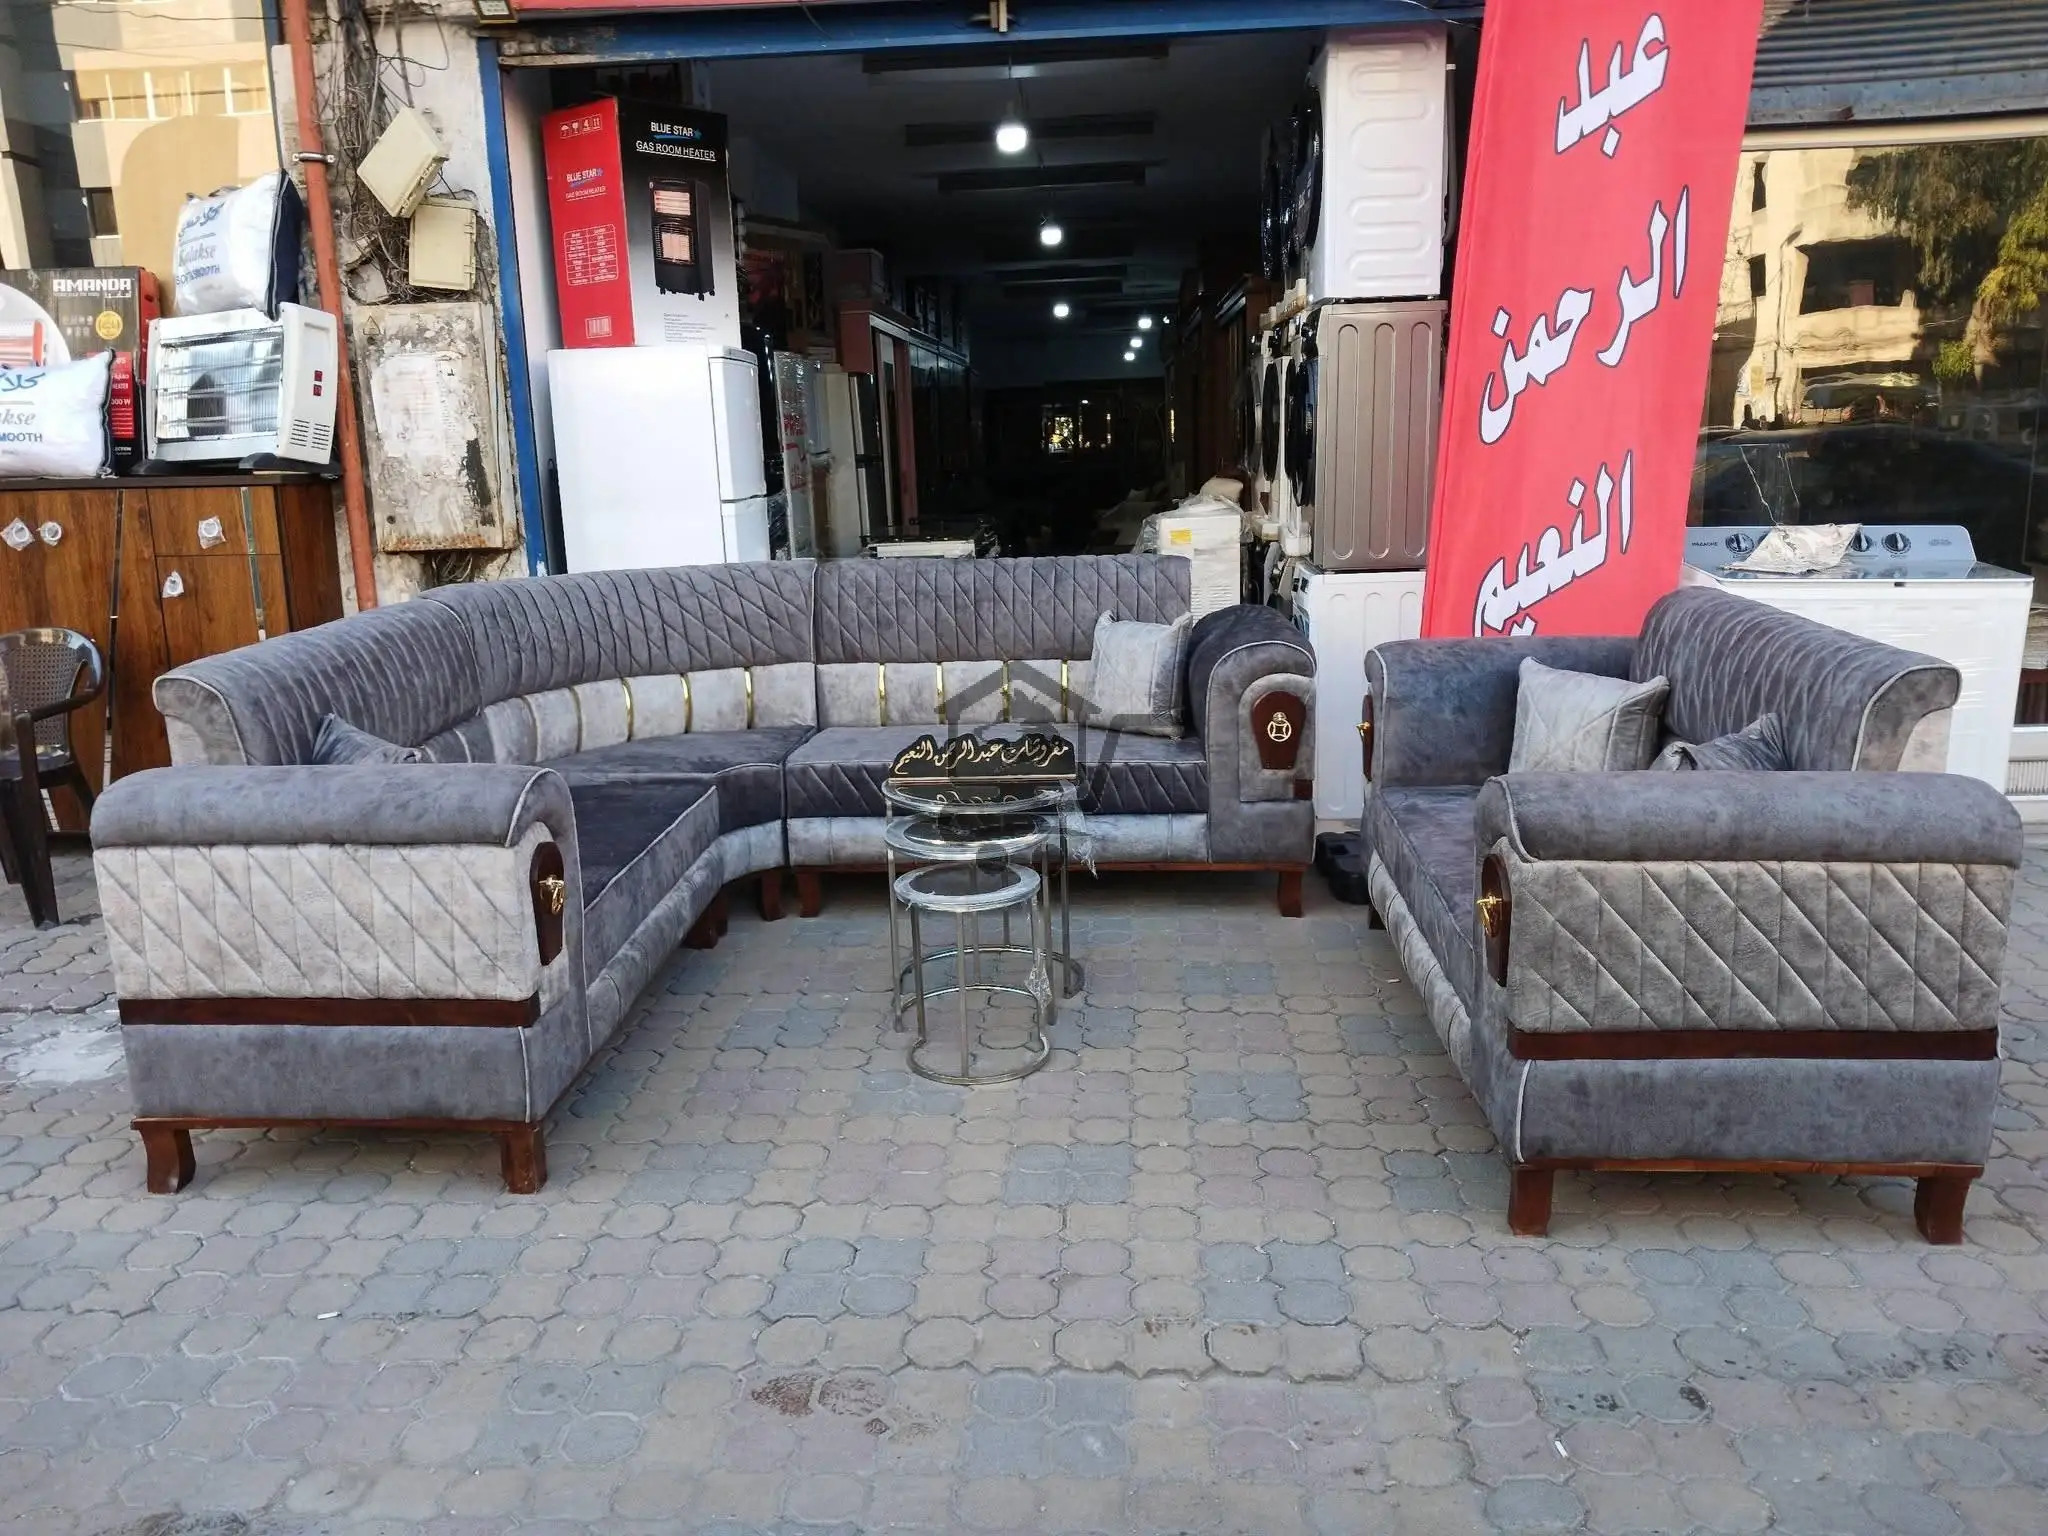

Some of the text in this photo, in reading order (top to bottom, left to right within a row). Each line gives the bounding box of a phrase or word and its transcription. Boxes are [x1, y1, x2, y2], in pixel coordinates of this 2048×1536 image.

[1555, 12, 1670, 159] عبد
[650, 121, 694, 137] BLUE STAR
[635, 140, 716, 160] GAS ROOM HEATER
[566, 168, 598, 183] BLUE STAR
[53, 279, 132, 292] AMANDA
[1479, 184, 1690, 445] الرحمن
[0, 408, 37, 426] kse
[1473, 449, 1633, 638] النعيم
[932, 738, 974, 770] الرحمن
[970, 743, 1004, 763] عبد
[1000, 737, 1069, 767] مفروشات
